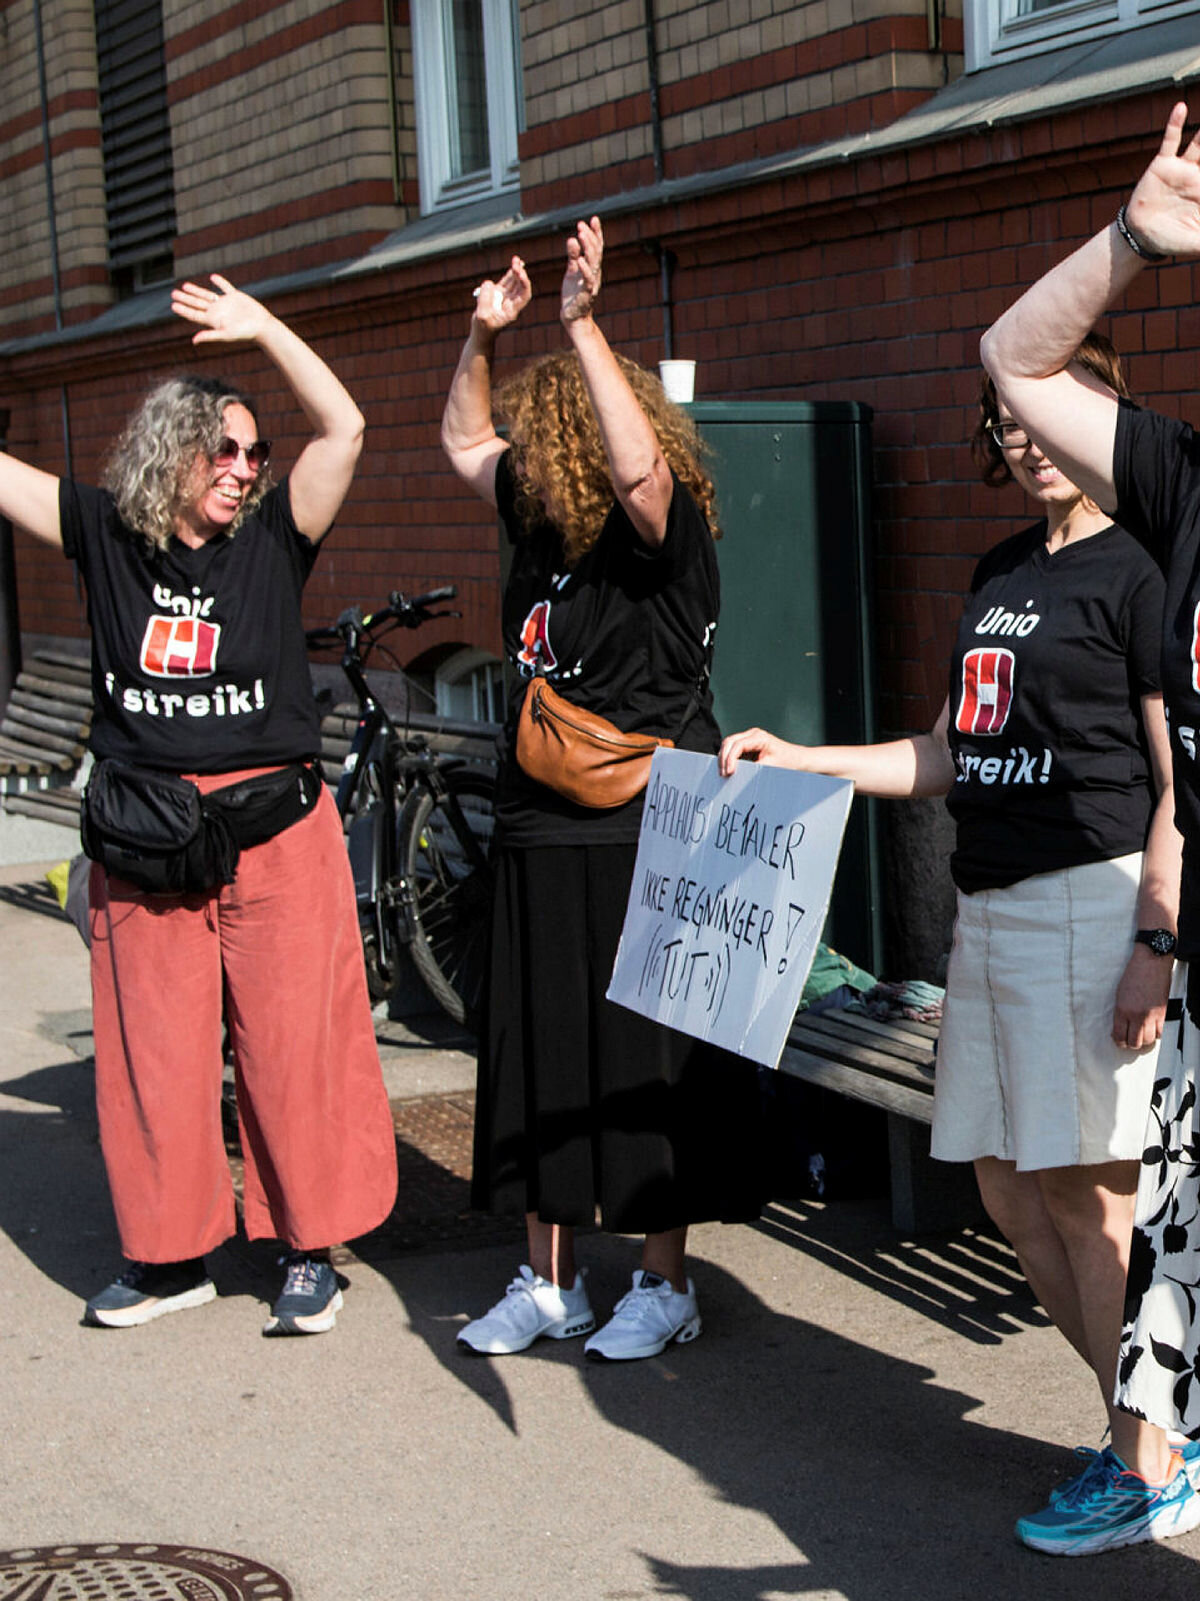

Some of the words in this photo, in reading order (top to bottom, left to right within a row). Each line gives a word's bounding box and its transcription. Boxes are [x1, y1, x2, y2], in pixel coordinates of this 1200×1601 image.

[975, 600, 1040, 637] Unio
[123, 678, 265, 718] streik!
[643, 772, 706, 845] APPLAUS
[714, 802, 805, 880] BETALER
